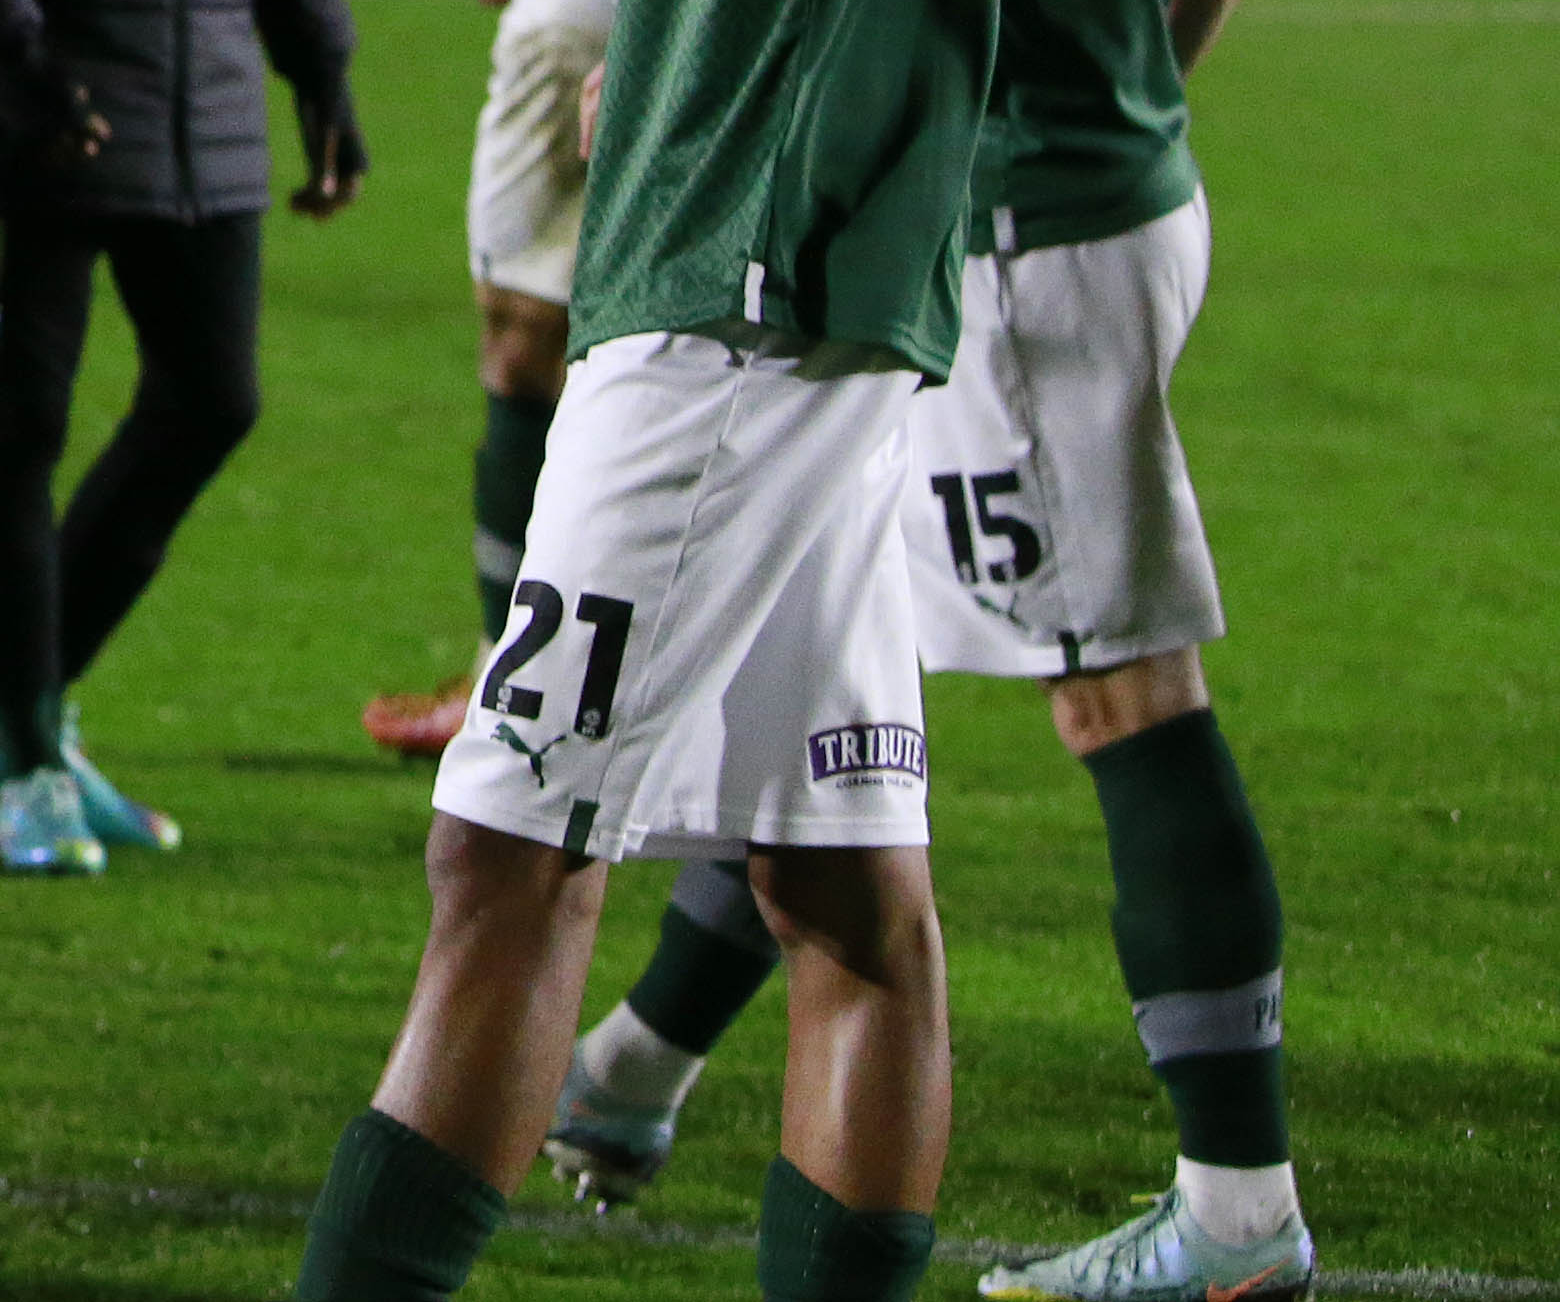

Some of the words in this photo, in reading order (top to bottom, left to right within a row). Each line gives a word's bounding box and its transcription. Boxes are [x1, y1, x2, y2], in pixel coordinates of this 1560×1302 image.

[930, 470, 1040, 583] 15
[481, 580, 634, 739] 21
[818, 728, 922, 777] TRIBUTE
